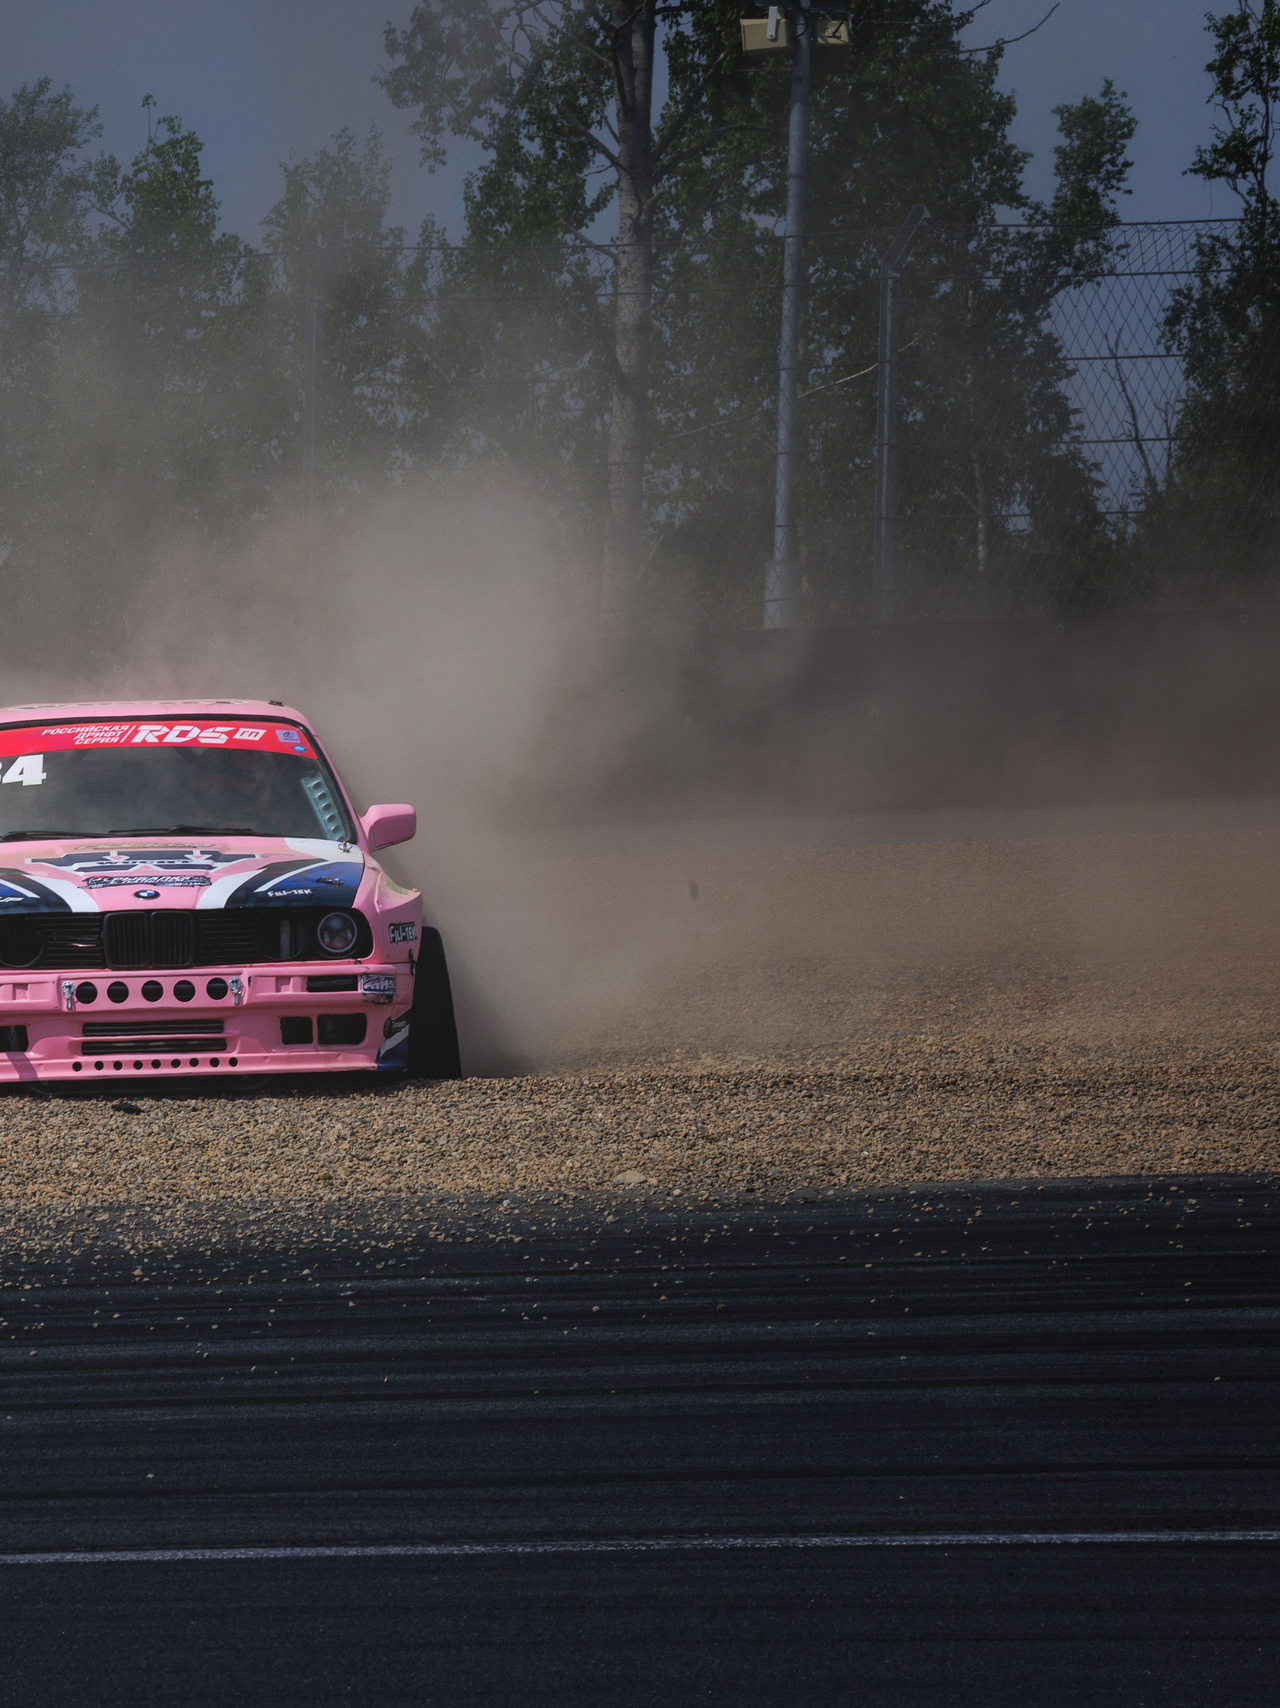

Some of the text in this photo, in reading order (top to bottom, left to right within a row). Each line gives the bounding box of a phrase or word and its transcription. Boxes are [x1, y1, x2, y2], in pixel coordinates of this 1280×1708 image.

[41, 724, 130, 736] РОССИЙСКАЯ
[131, 725, 236, 744] RDS
[73, 731, 123, 740] ДРИФТ
[74, 737, 120, 745] СЕРИЯ
